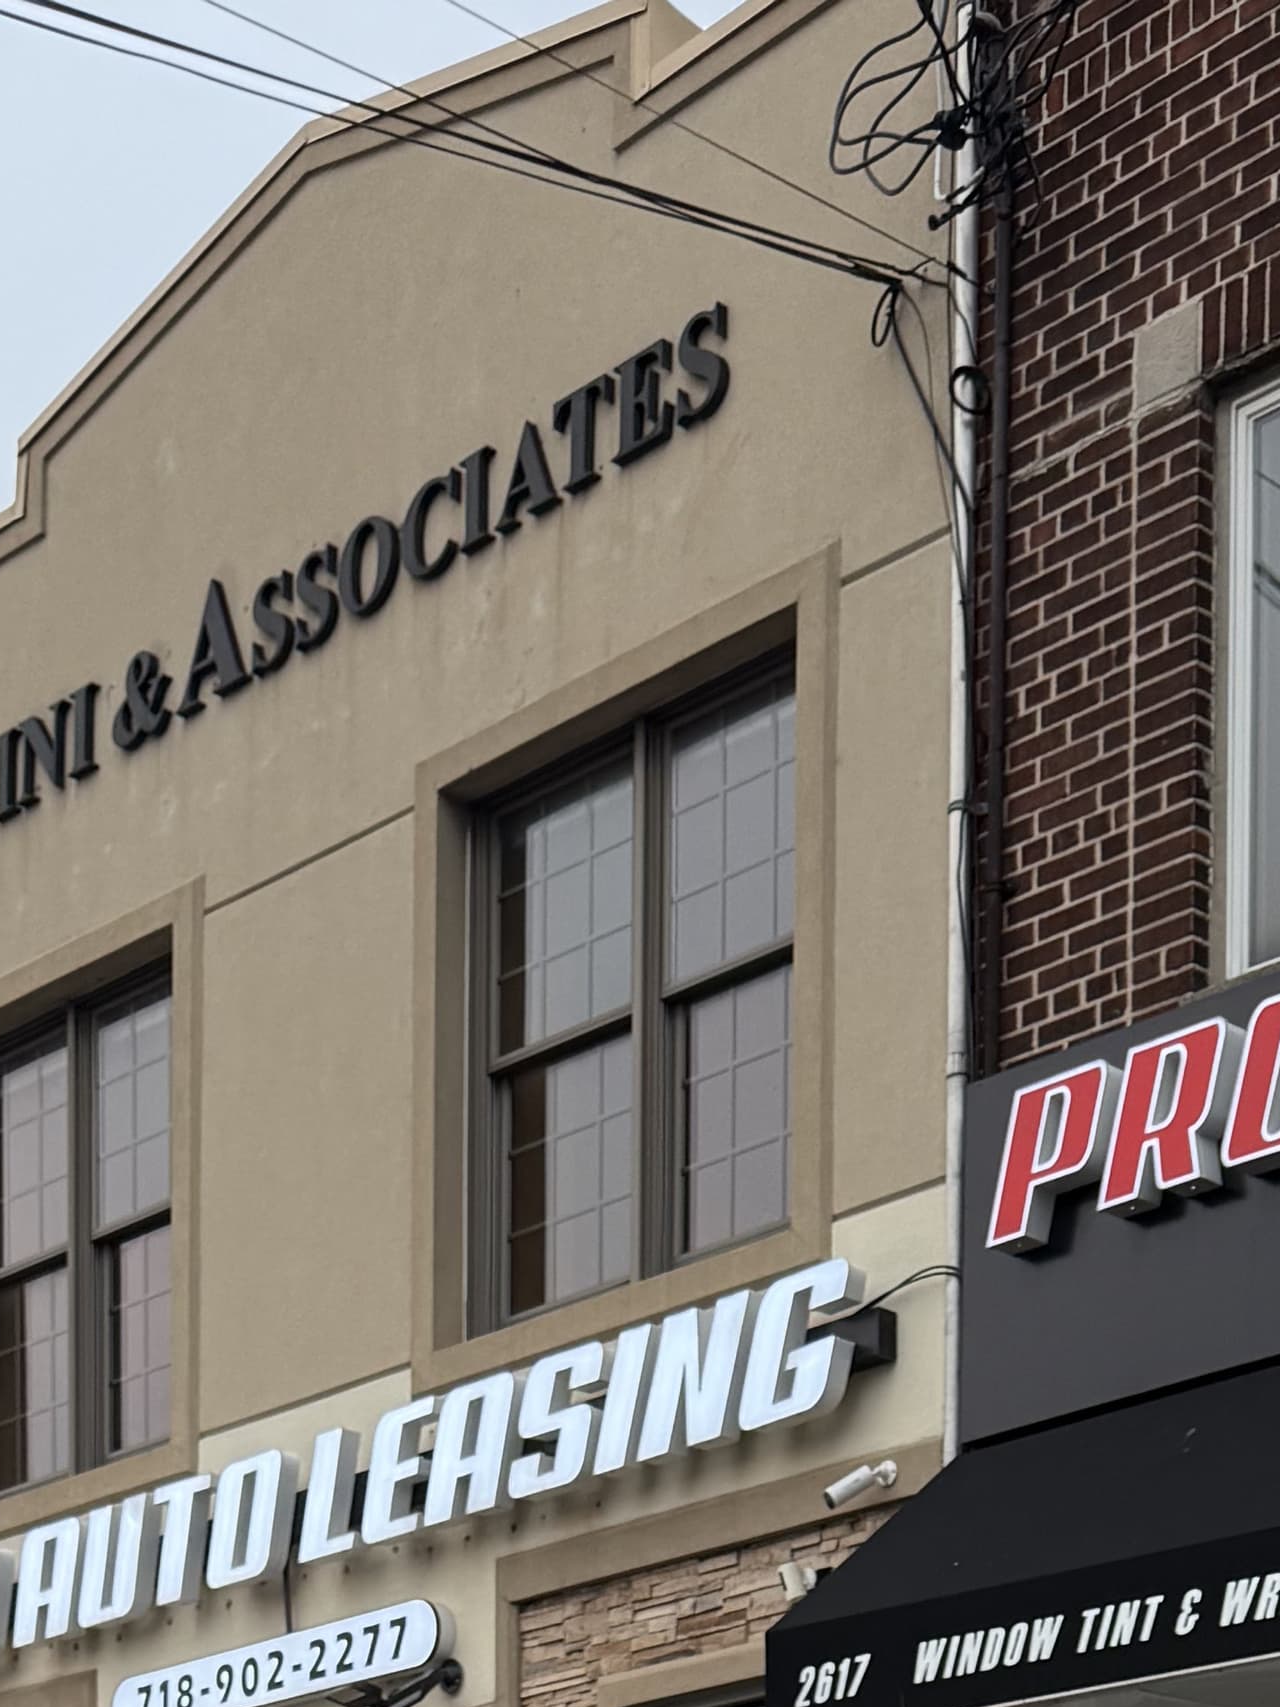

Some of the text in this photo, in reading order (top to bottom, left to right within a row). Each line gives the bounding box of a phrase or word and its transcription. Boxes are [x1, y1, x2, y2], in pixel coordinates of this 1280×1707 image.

[112, 650, 173, 752] &
[178, 301, 731, 718] ASSOCIATES
[12, 1449, 284, 1650] AUTO
[297, 1257, 852, 1565] LEASING
[794, 1653, 871, 1707] 2617
[913, 1613, 1064, 1685] WINDOW
[1077, 1594, 1163, 1654] TINT
[1175, 1587, 1200, 1636] &
